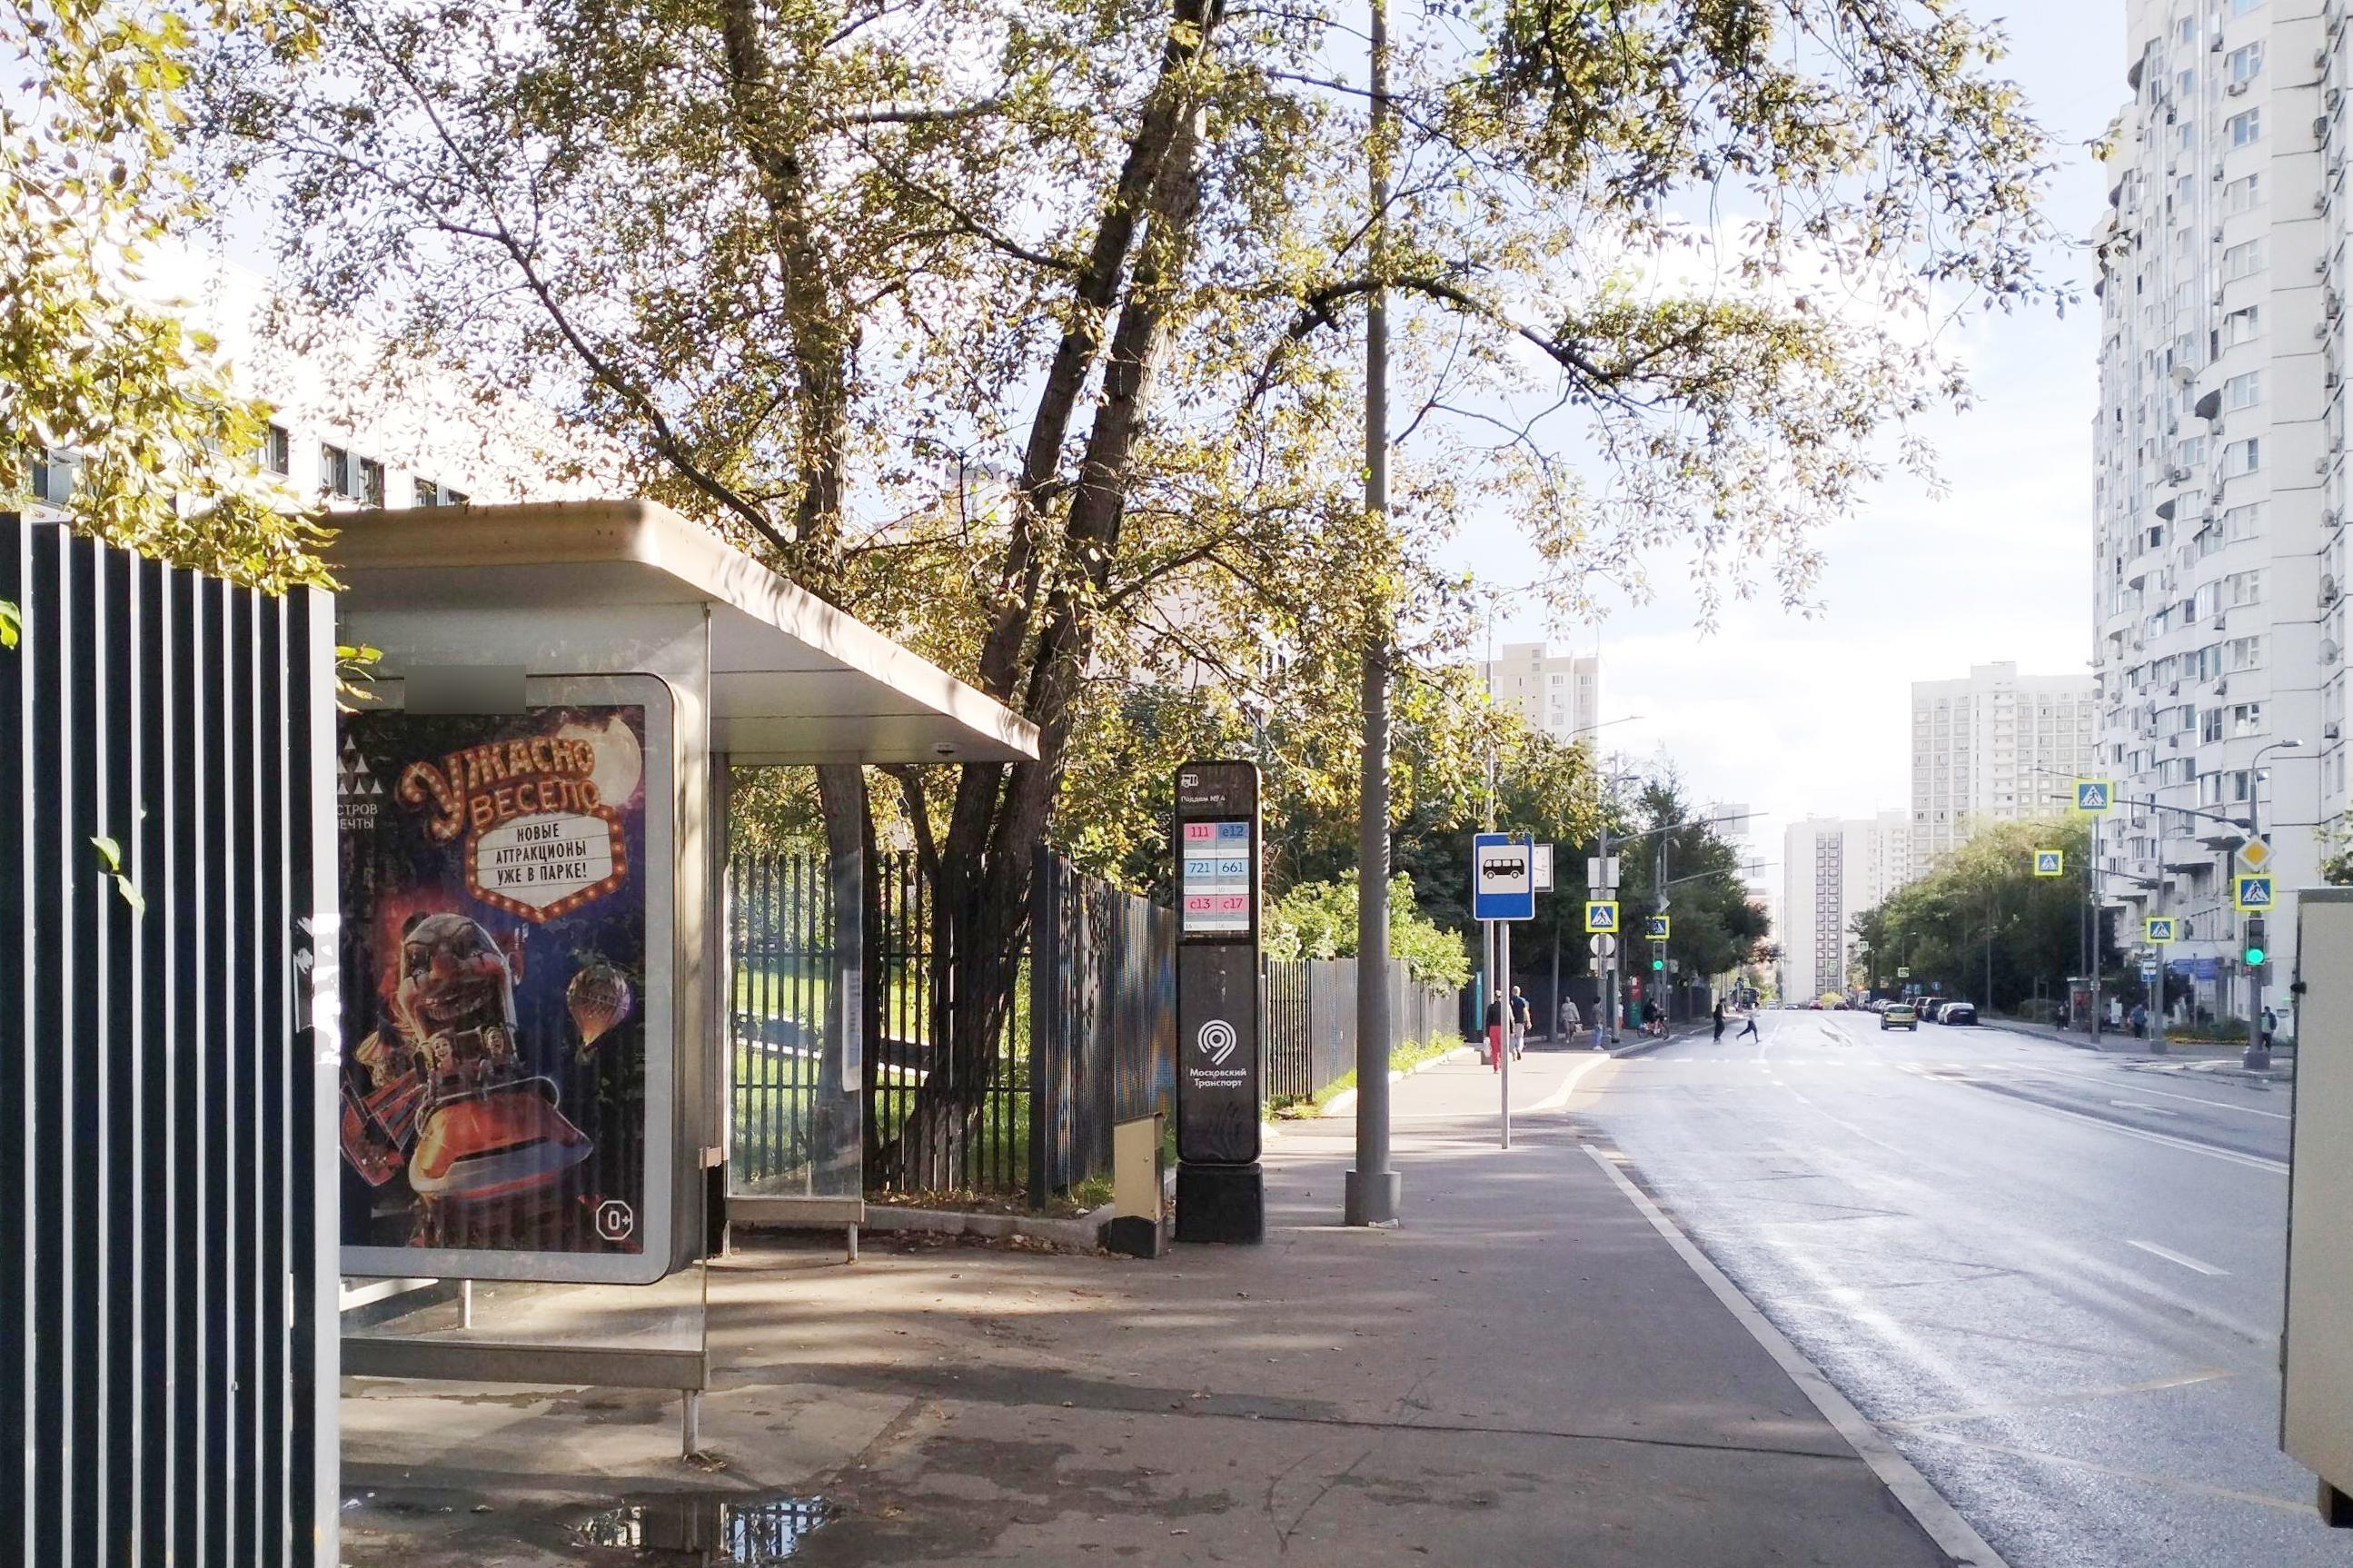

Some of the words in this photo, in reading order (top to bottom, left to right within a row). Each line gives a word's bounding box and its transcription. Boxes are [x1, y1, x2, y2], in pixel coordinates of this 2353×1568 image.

[399, 737, 597, 842] УЖАСНО
[470, 779, 601, 825] ВЕСЕЛО
[337, 803, 378, 816] СТРОВ
[337, 817, 374, 829] ЕЧТЫ
[516, 823, 560, 841] НОВЫЕ
[1190, 826, 1209, 838] 111
[495, 840, 587, 864] АТТРАКЦИОНЫ
[497, 867, 521, 886] УЖЕ
[527, 866, 534, 881] В
[540, 861, 589, 881] ПАРКЕ!
[1190, 862, 1210, 873] 721
[1222, 862, 1244, 873] 661
[1189, 1067, 1247, 1077] Московский
[1194, 1078, 1243, 1089] Транспорт
[608, 1210, 630, 1230] 0+
